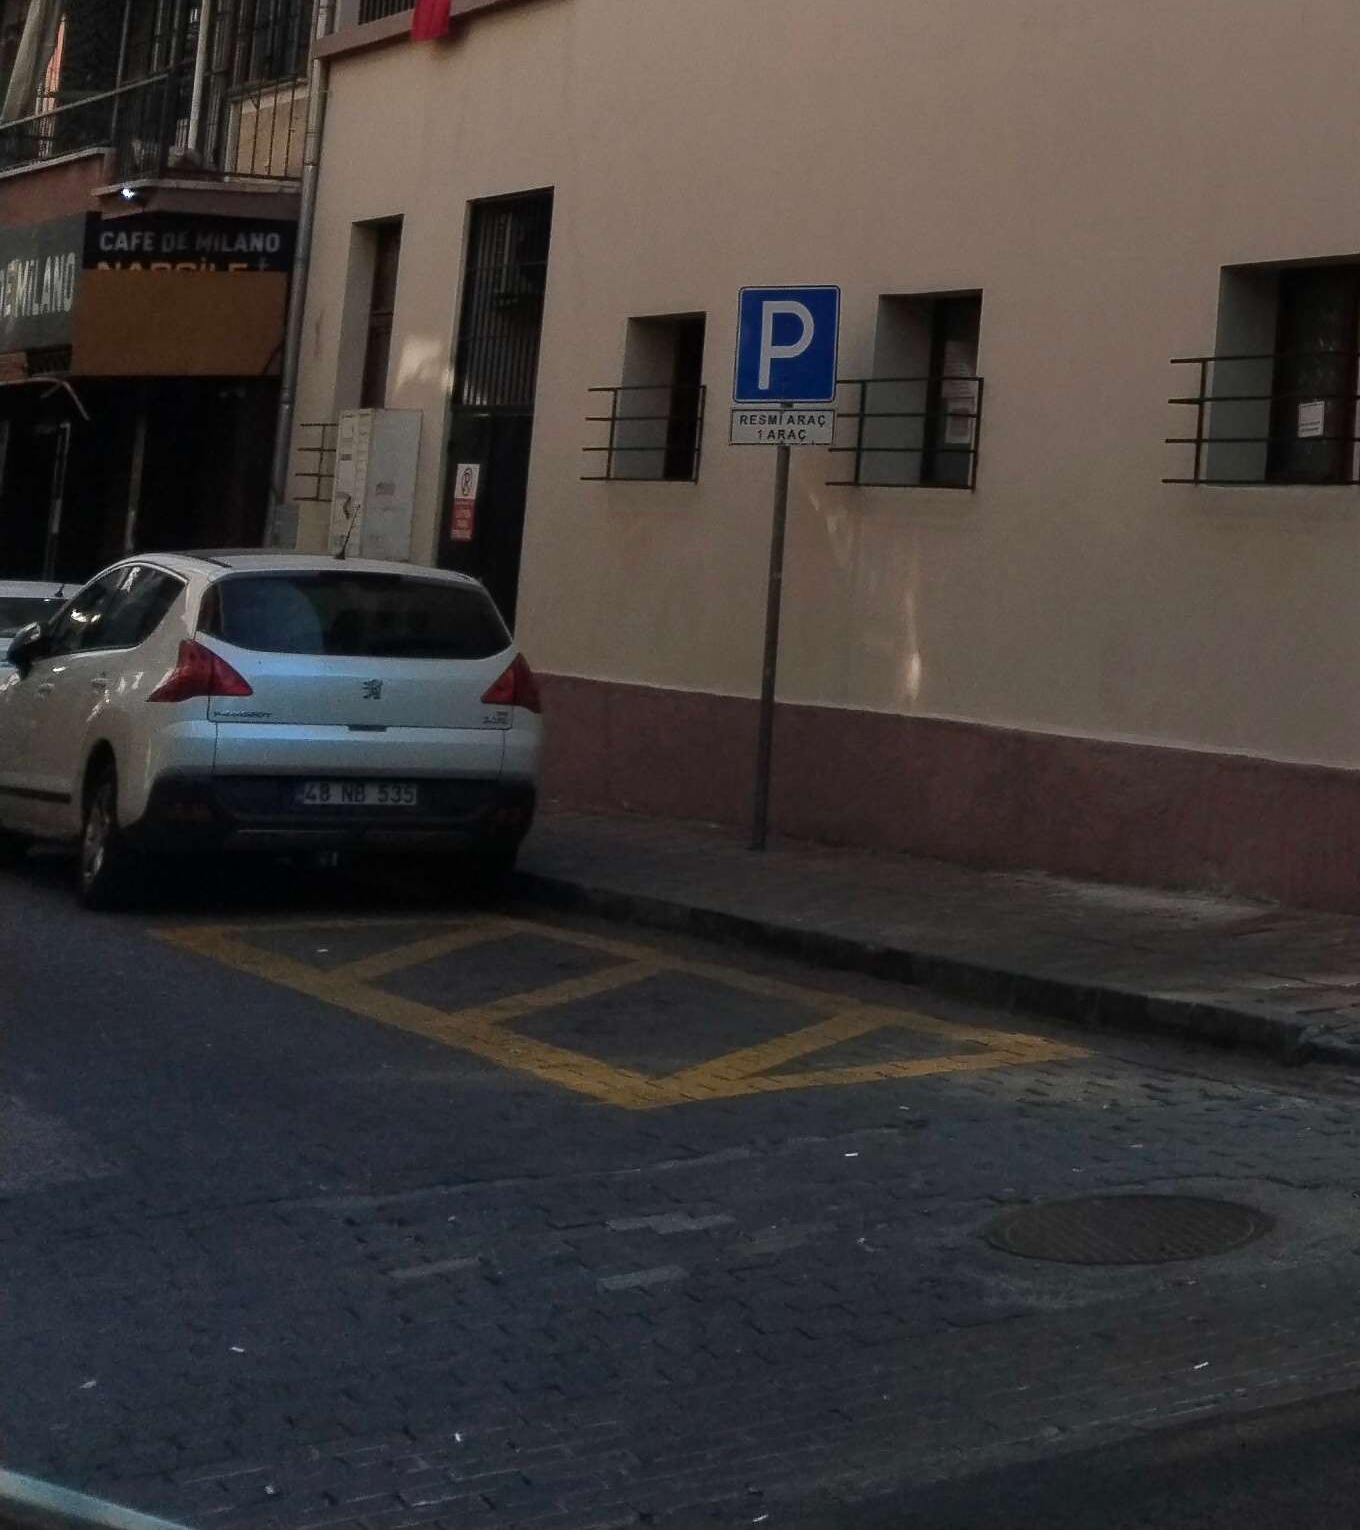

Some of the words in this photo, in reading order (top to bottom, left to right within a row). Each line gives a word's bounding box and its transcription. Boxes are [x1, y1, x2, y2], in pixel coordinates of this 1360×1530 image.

[99, 231, 155, 252] CAFE
[161, 231, 189, 253] DE
[757, 300, 815, 391] P
[786, 414, 826, 427] ARAÇ
[767, 429, 808, 442] ARAÇ
[377, 783, 415, 804] 535
